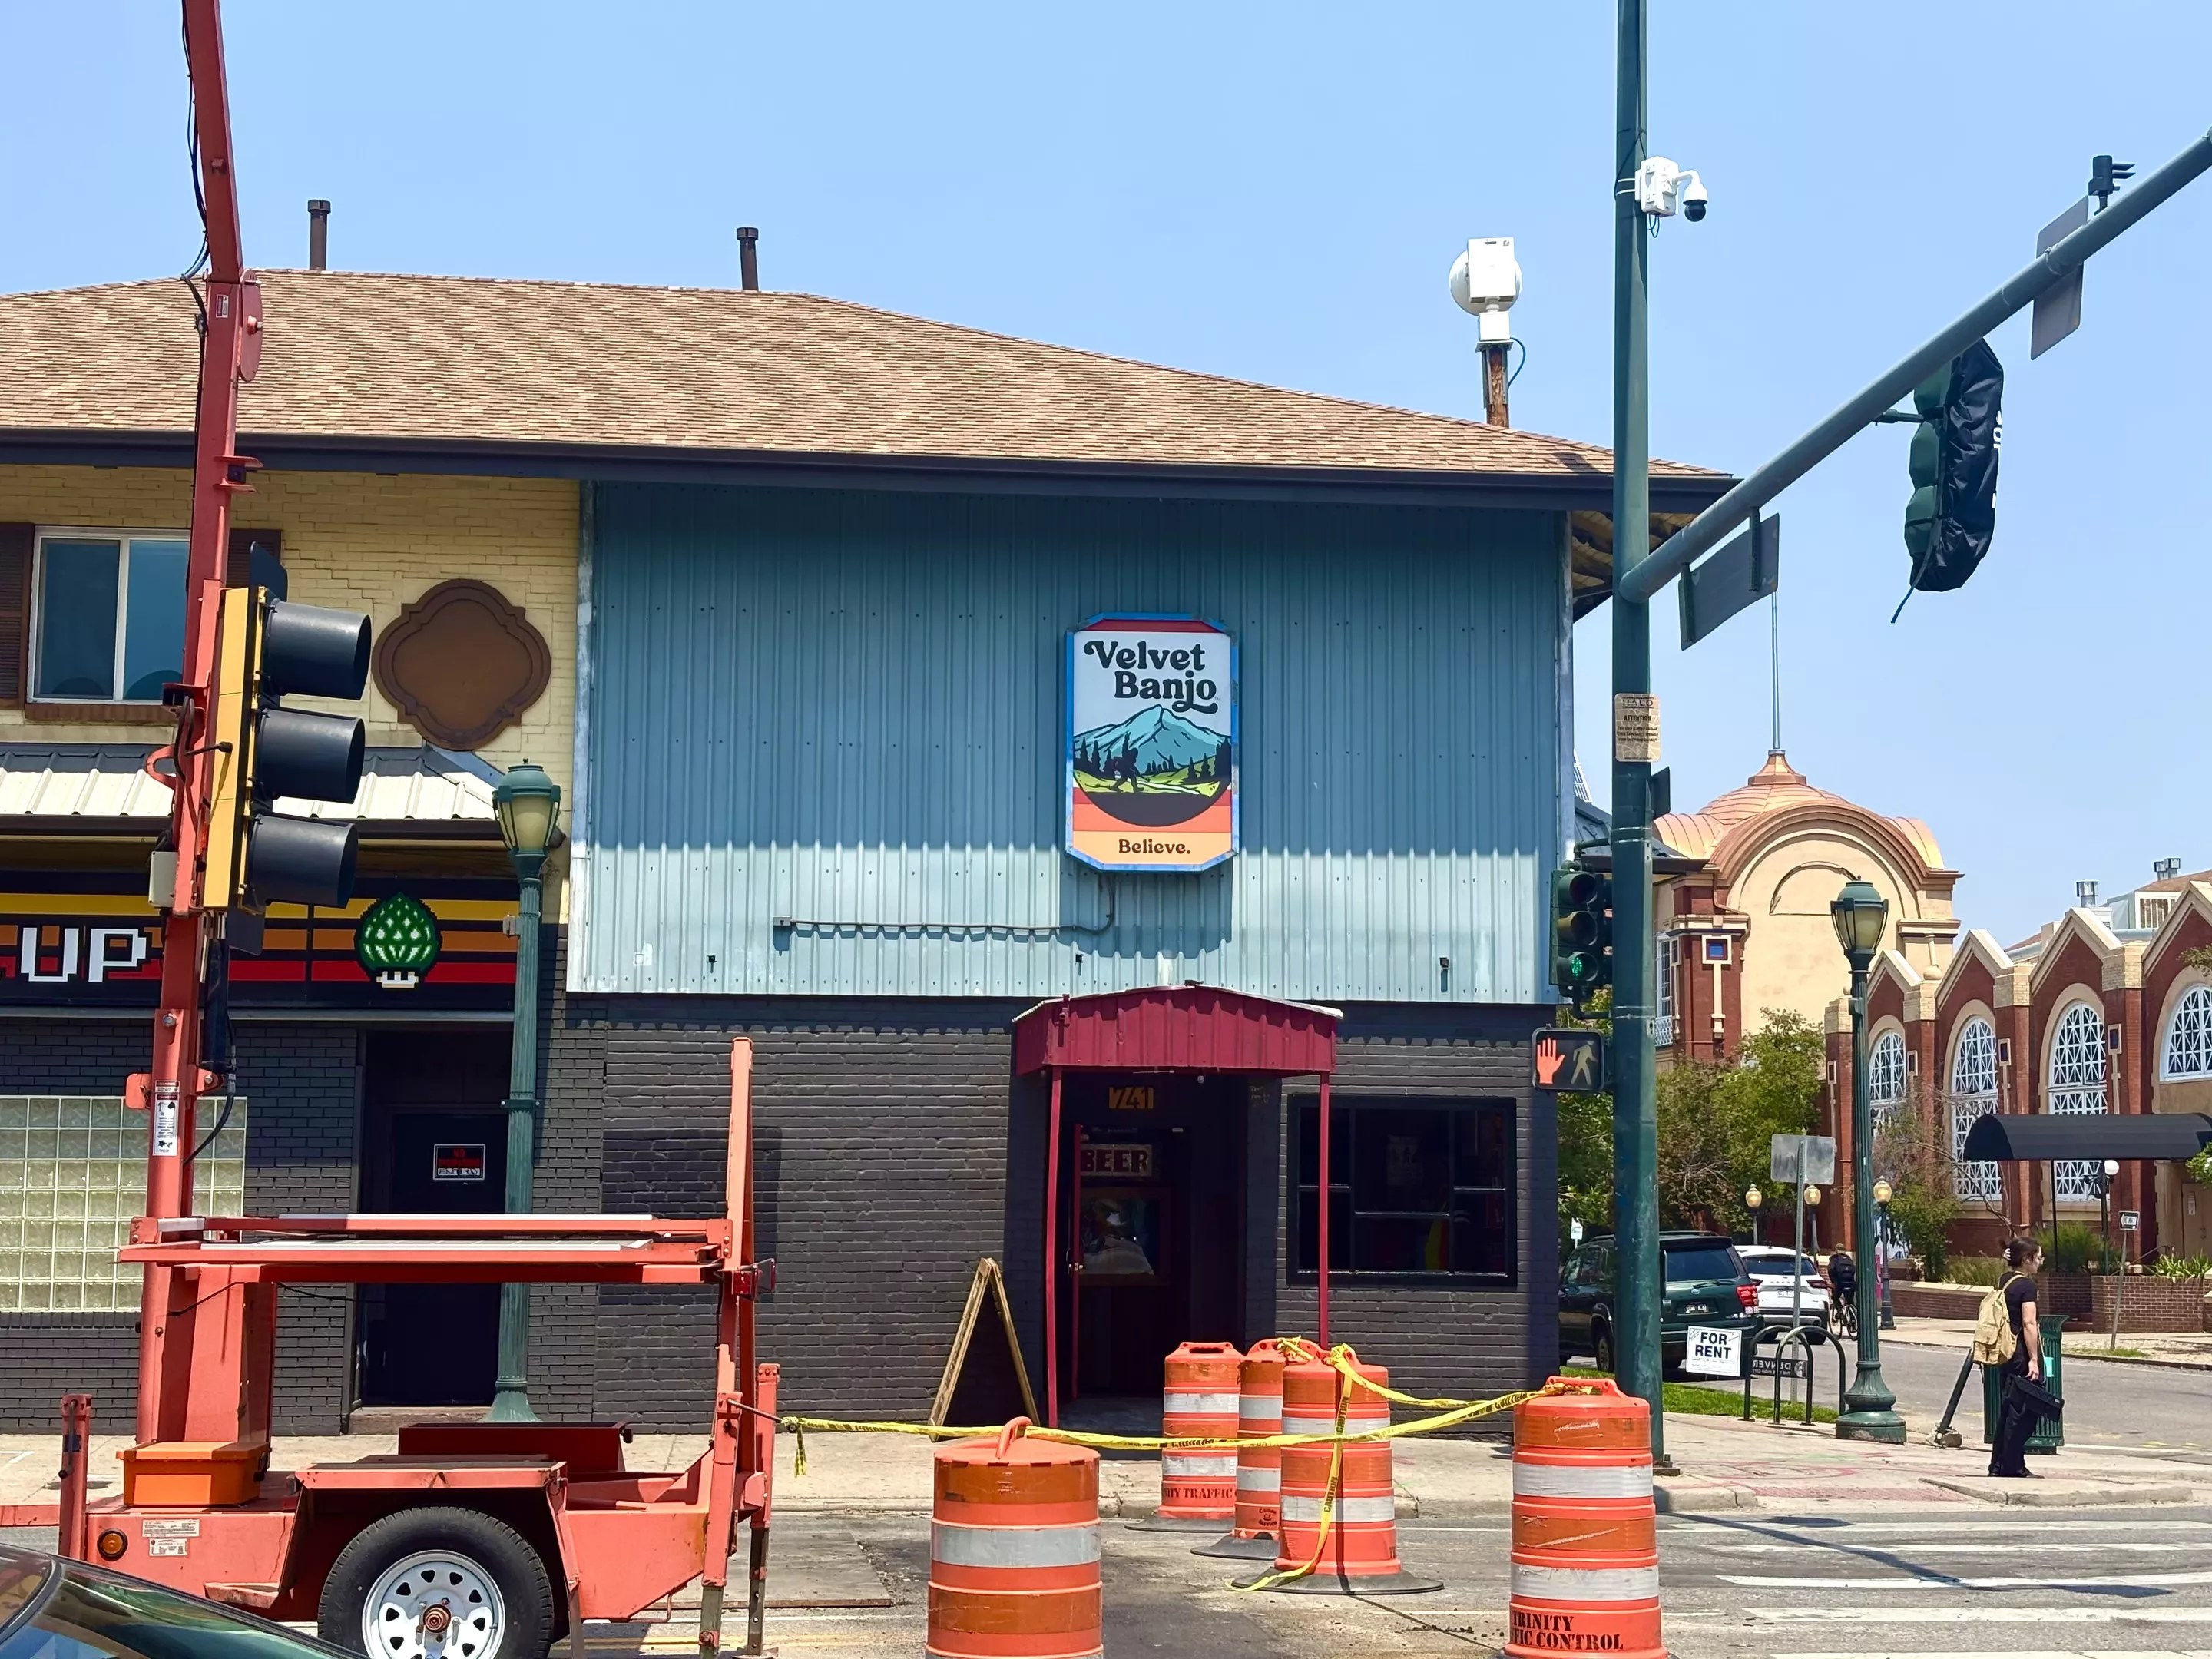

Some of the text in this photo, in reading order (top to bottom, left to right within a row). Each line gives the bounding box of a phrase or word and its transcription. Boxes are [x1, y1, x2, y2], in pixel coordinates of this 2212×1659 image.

[1084, 641, 1206, 671] Velvet
[1114, 670, 1218, 714] Banjo
[1118, 839, 1191, 854] Believe.
[21, 927, 147, 982] UP
[1113, 1087, 1150, 1109] 741
[1080, 1149, 1149, 1172] BEER
[1700, 1332, 1727, 1345] FOR
[1695, 1344, 1731, 1359] RENT
[1336, 1396, 1349, 1435] CAUTION
[1184, 1488, 1233, 1498] TRAFFIC
[1323, 1476, 1338, 1512] CAUTION
[1512, 1610, 1575, 1631] TRINITY
[1536, 1632, 1624, 1650] CONTROL
